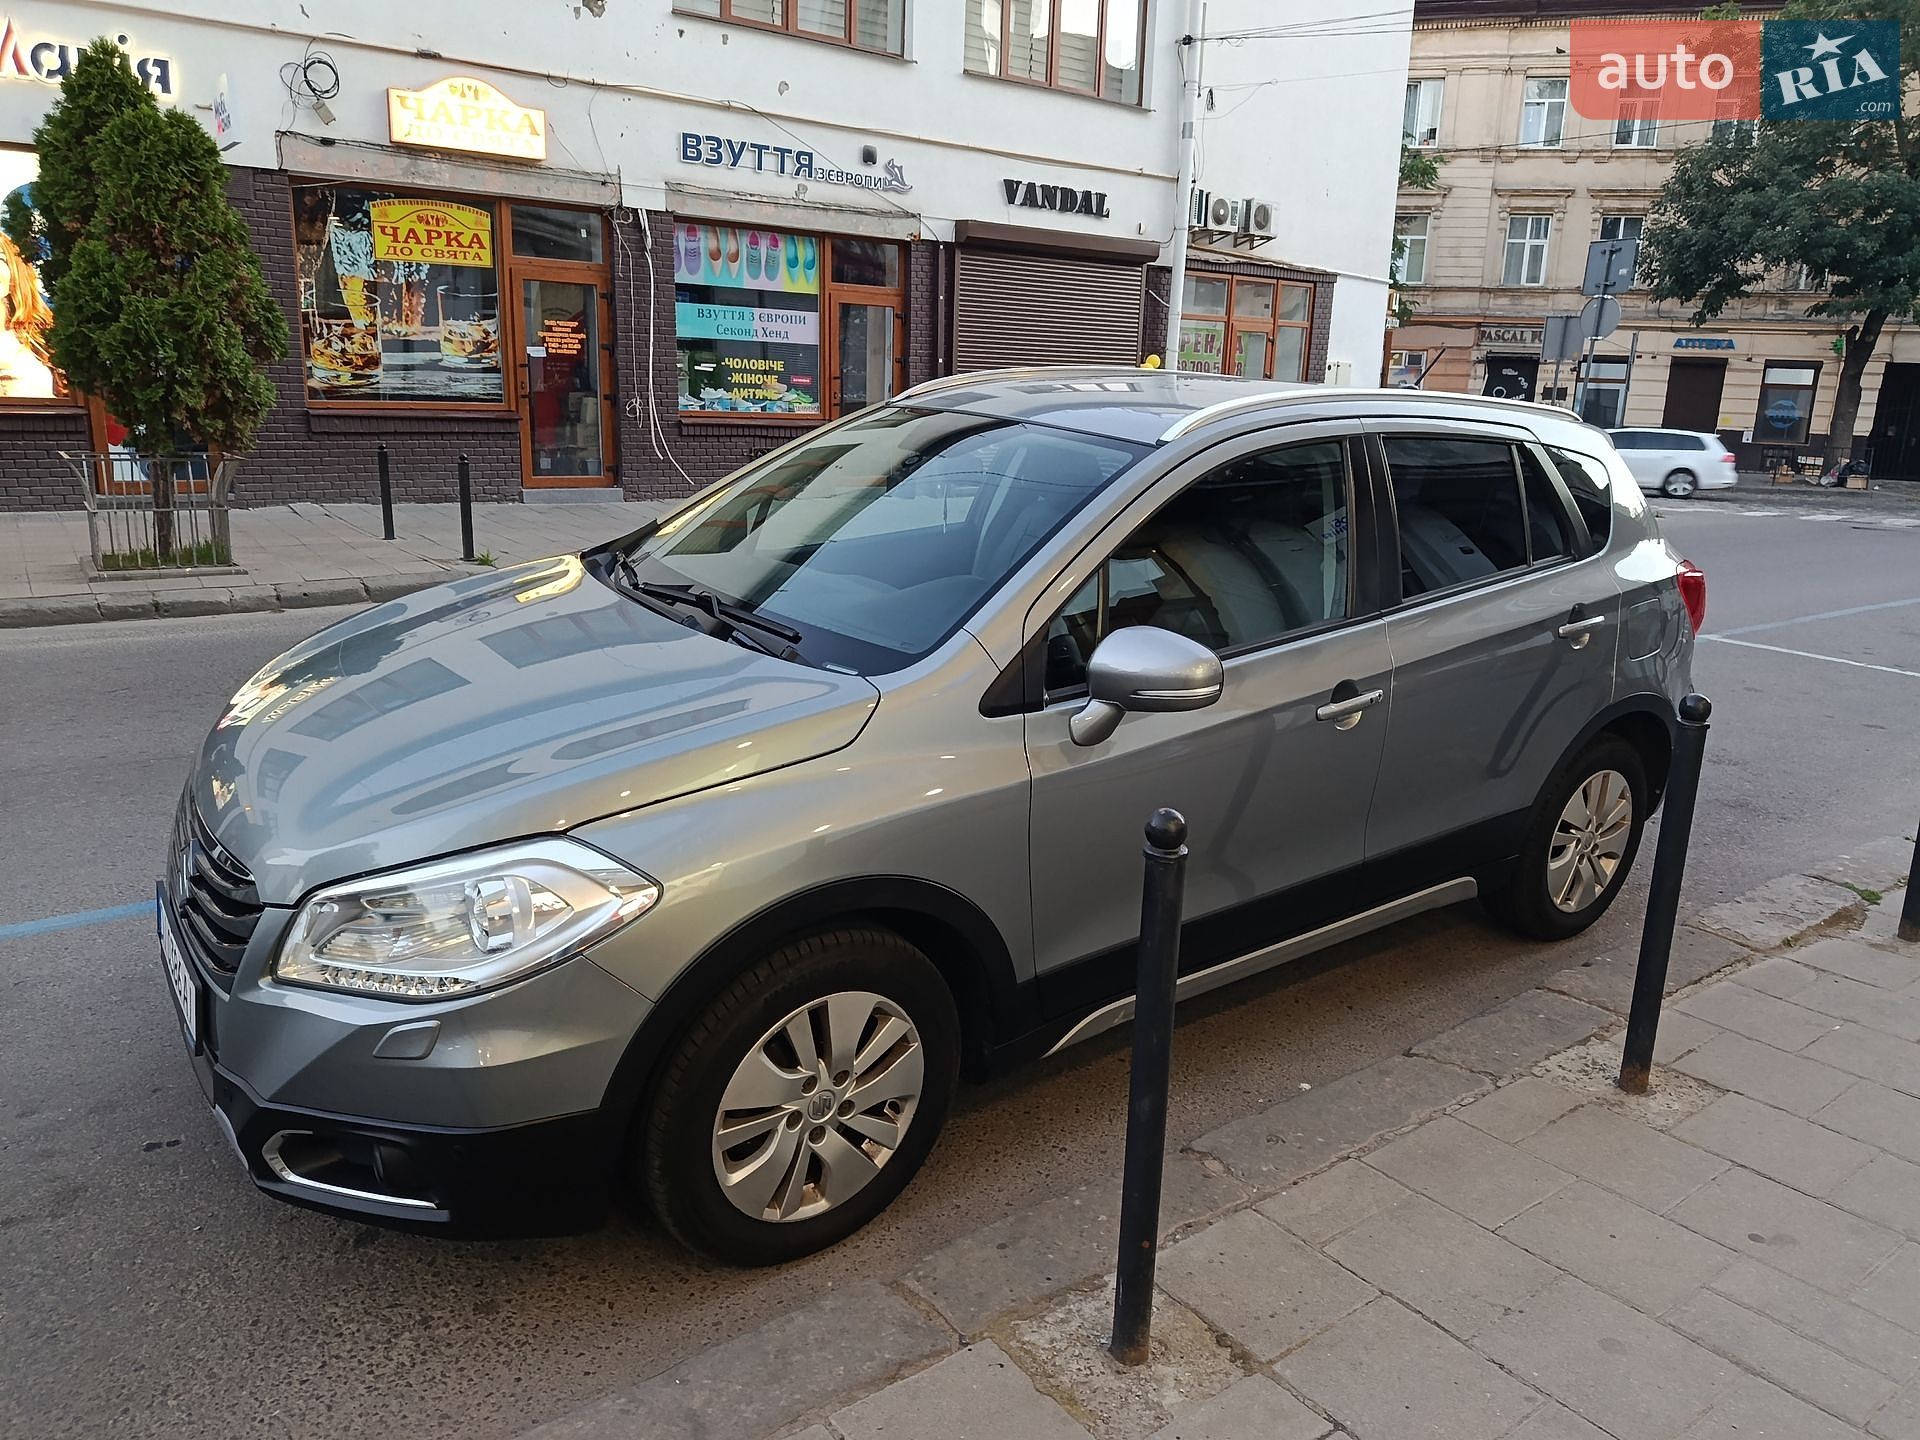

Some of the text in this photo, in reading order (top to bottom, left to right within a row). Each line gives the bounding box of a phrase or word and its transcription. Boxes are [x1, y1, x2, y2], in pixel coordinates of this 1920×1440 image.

[396, 95, 540, 137] ЧАРКА
[681, 132, 814, 179] ВЗУТТЯ
[1003, 179, 1110, 218] VANDAL
[378, 225, 487, 249] ЧАРКА
[384, 245, 483, 261] ДО СВЯТА
[697, 308, 745, 321] ВЗУТТЯ
[758, 312, 807, 326] ЄВРОПИ
[716, 324, 790, 340] Секонд Хенд
[1480, 329, 1527, 343] PASCAL
